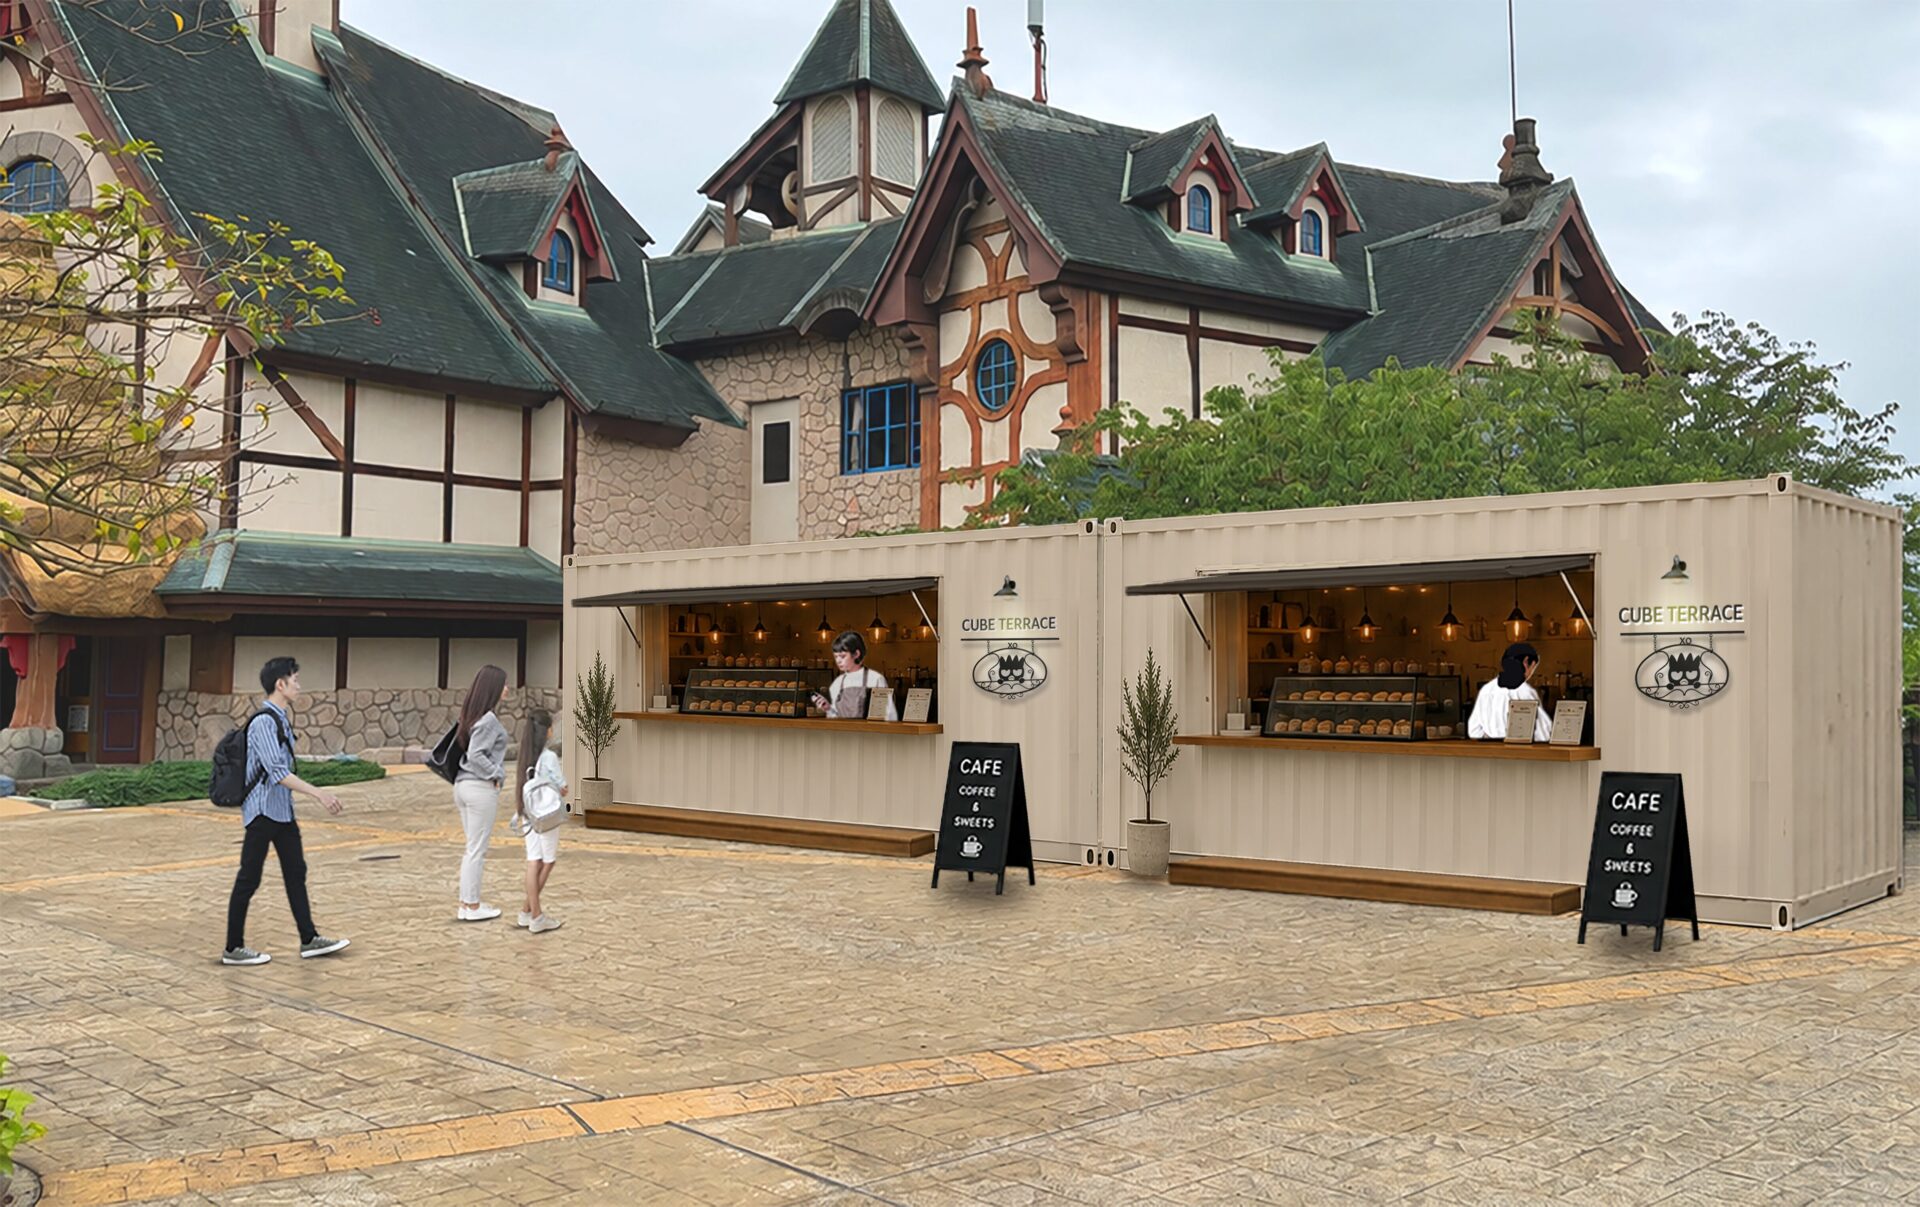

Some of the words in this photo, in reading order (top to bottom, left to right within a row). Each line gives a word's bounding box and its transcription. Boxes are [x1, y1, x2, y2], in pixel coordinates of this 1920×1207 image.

[1618, 606, 1663, 623] CUBE
[1667, 604, 1743, 622] TERRACE
[962, 618, 995, 631] CUBE
[998, 616, 1056, 630] TERRACE
[960, 758, 1002, 775] CAFE
[958, 785, 996, 797] COFFEE
[1611, 792, 1661, 811] CAFE
[953, 816, 995, 829] SWEETS
[1610, 823, 1654, 837] COFFEE
[1604, 859, 1652, 874] SWEETS
